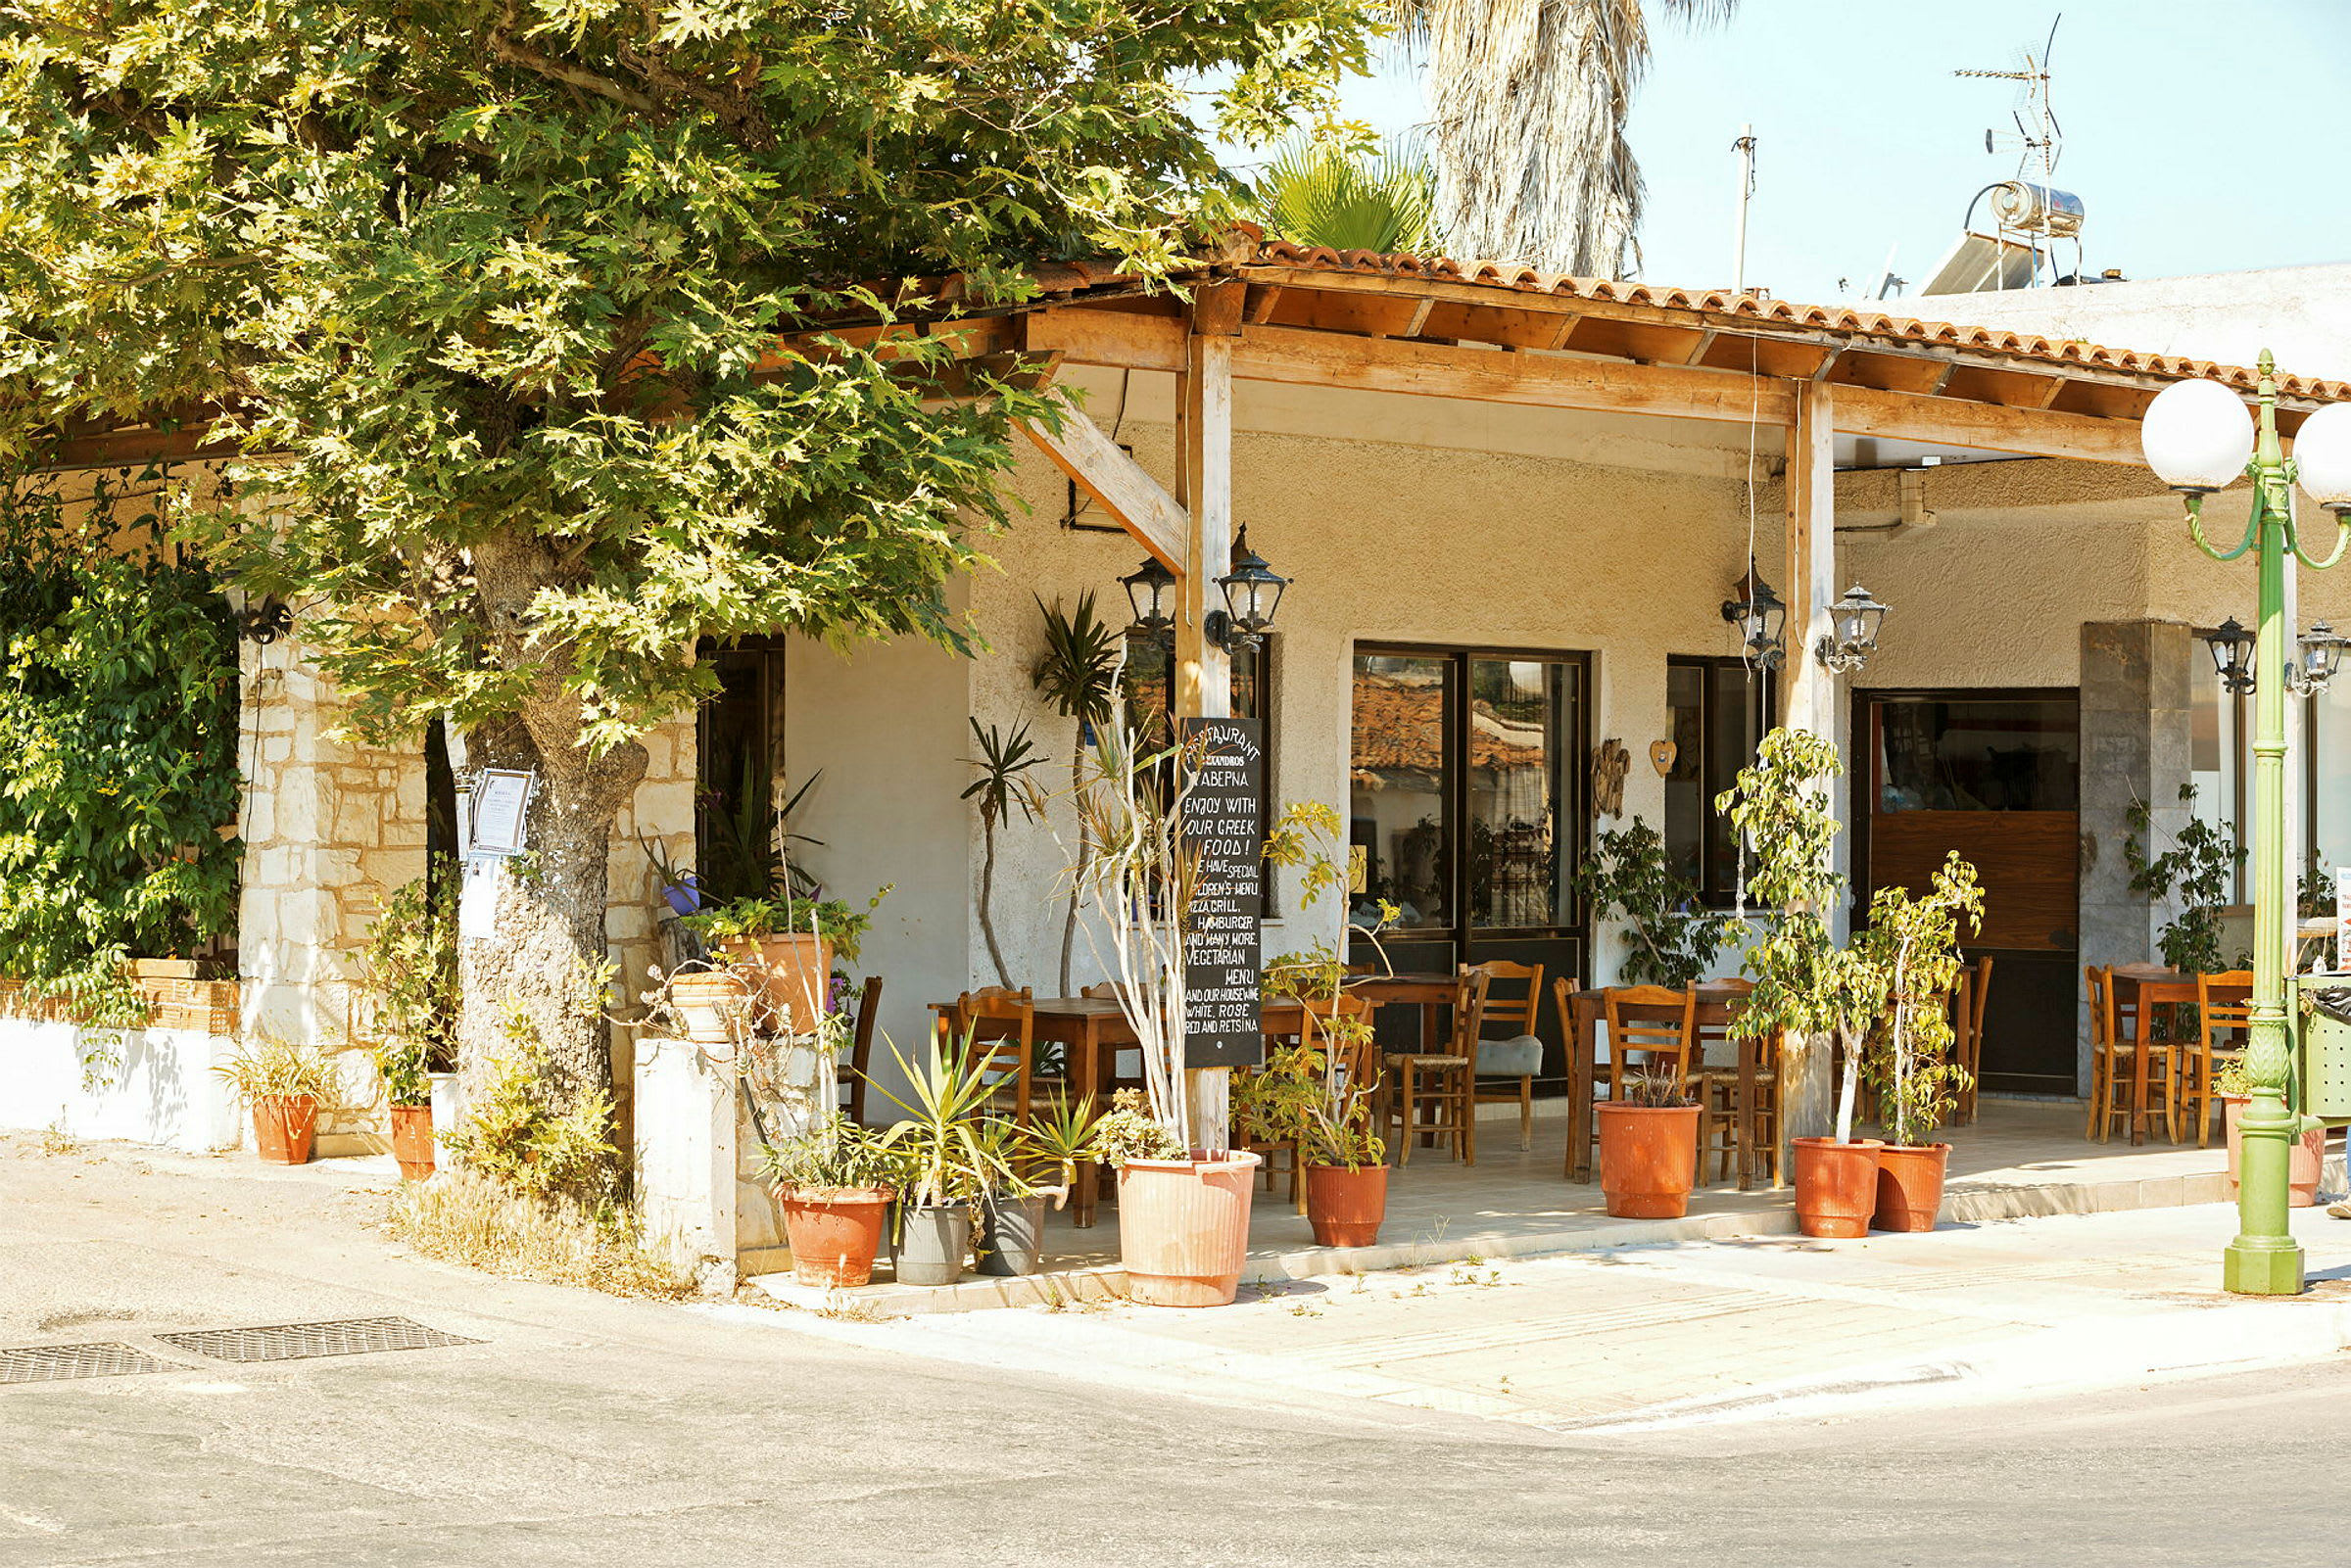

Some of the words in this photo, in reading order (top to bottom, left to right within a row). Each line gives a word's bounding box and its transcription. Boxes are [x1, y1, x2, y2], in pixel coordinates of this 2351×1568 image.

[1184, 797, 1221, 816] ENJOY
[1225, 796, 1256, 814] WITH
[1187, 819, 1214, 835] OUR
[1217, 819, 1255, 835] GREEK
[1187, 859, 1205, 874] E
[1206, 859, 1229, 873] HAVE
[1234, 882, 1259, 896] MENU
[1185, 932, 1205, 946] AND
[1224, 968, 1255, 986] MENU
[1184, 988, 1203, 1002] AND
[1203, 988, 1221, 1002] OUR
[1218, 1003, 1250, 1018] ROSE
[1201, 1021, 1218, 1033] AND
